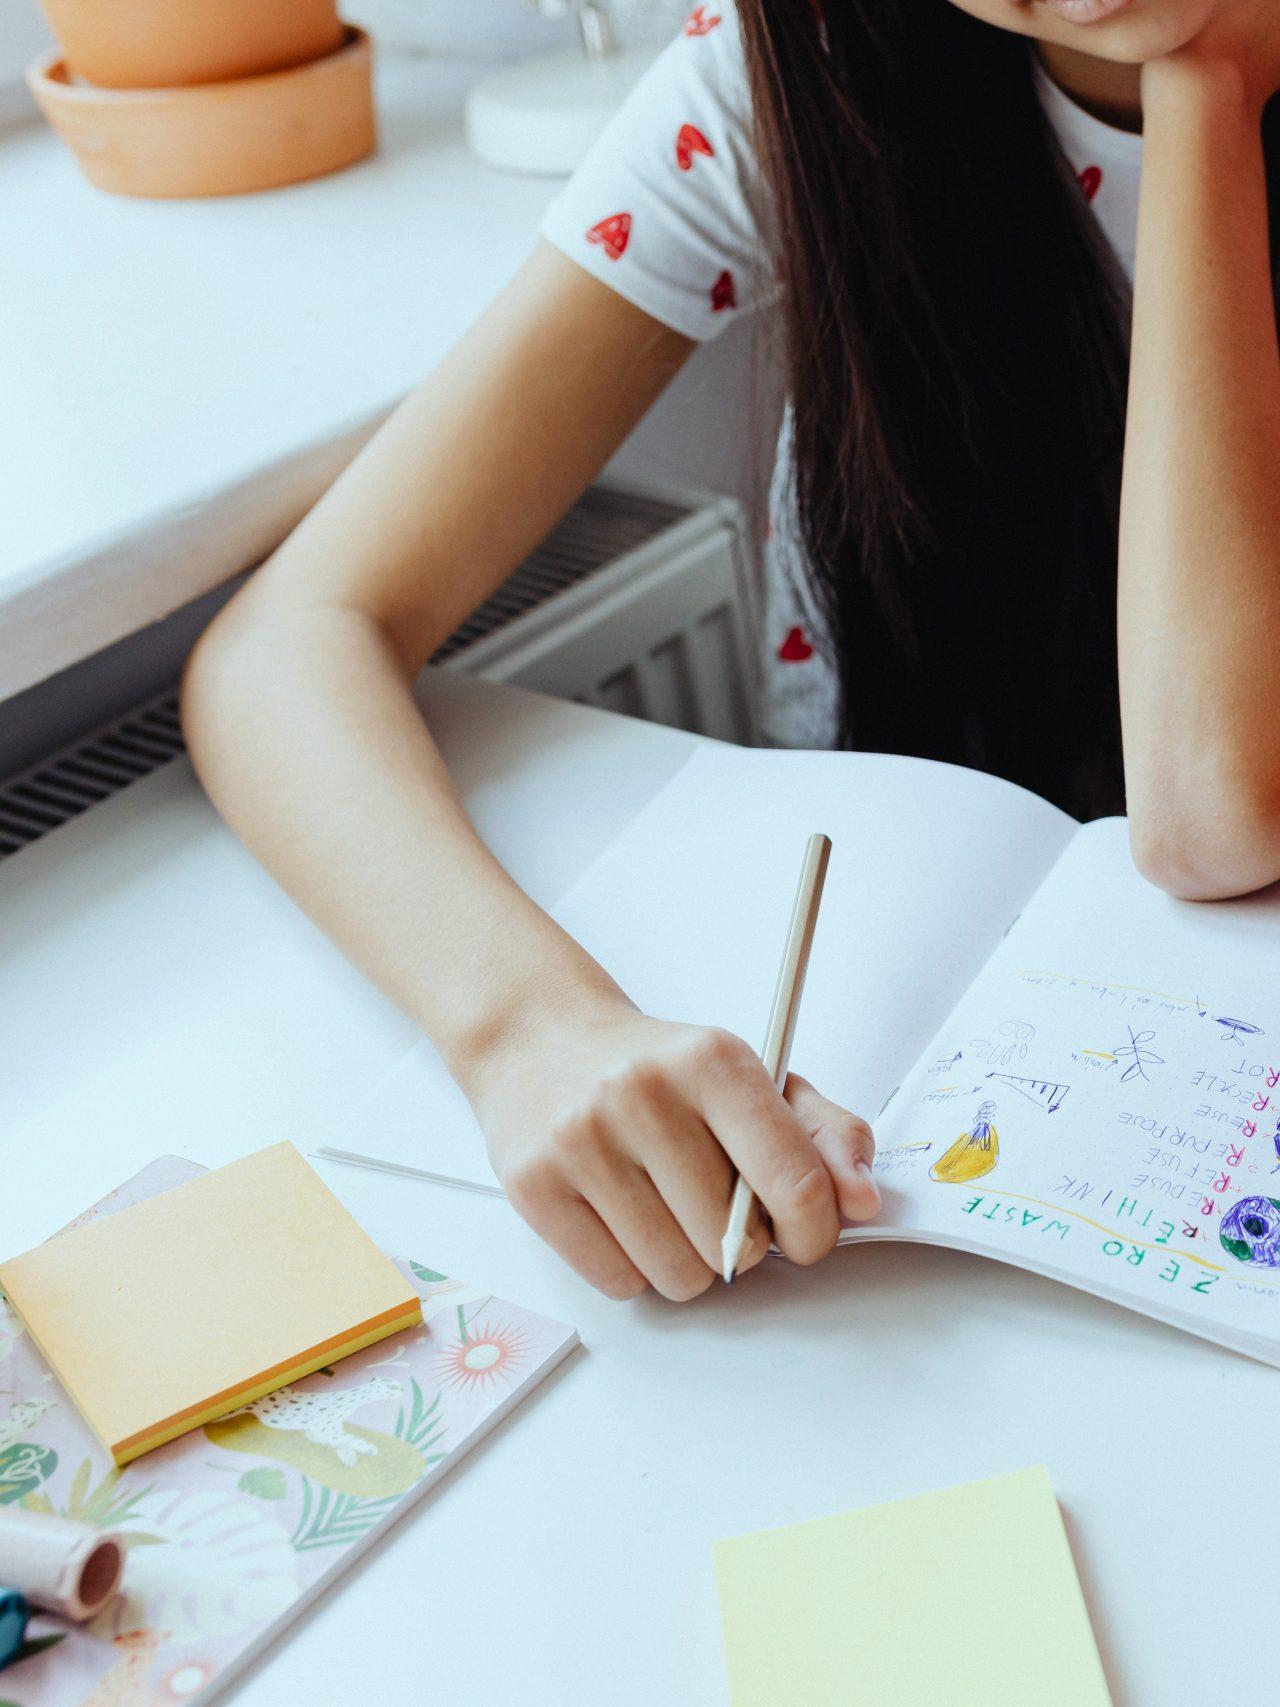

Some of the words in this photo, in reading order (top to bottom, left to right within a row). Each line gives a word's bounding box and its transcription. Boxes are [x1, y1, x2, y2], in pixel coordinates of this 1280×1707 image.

[1191, 1070, 1272, 1112] RECYCLE
[1117, 1111, 1245, 1168] REPURPOSE
[1194, 1104, 1257, 1138] REUSE
[1144, 1147, 1233, 1194] REFUSE
[961, 1195, 1071, 1240] WASTE
[1055, 1174, 1199, 1245] RETHINK
[1131, 1172, 1216, 1217] REDUSE
[1102, 1240, 1221, 1295] ZERO
